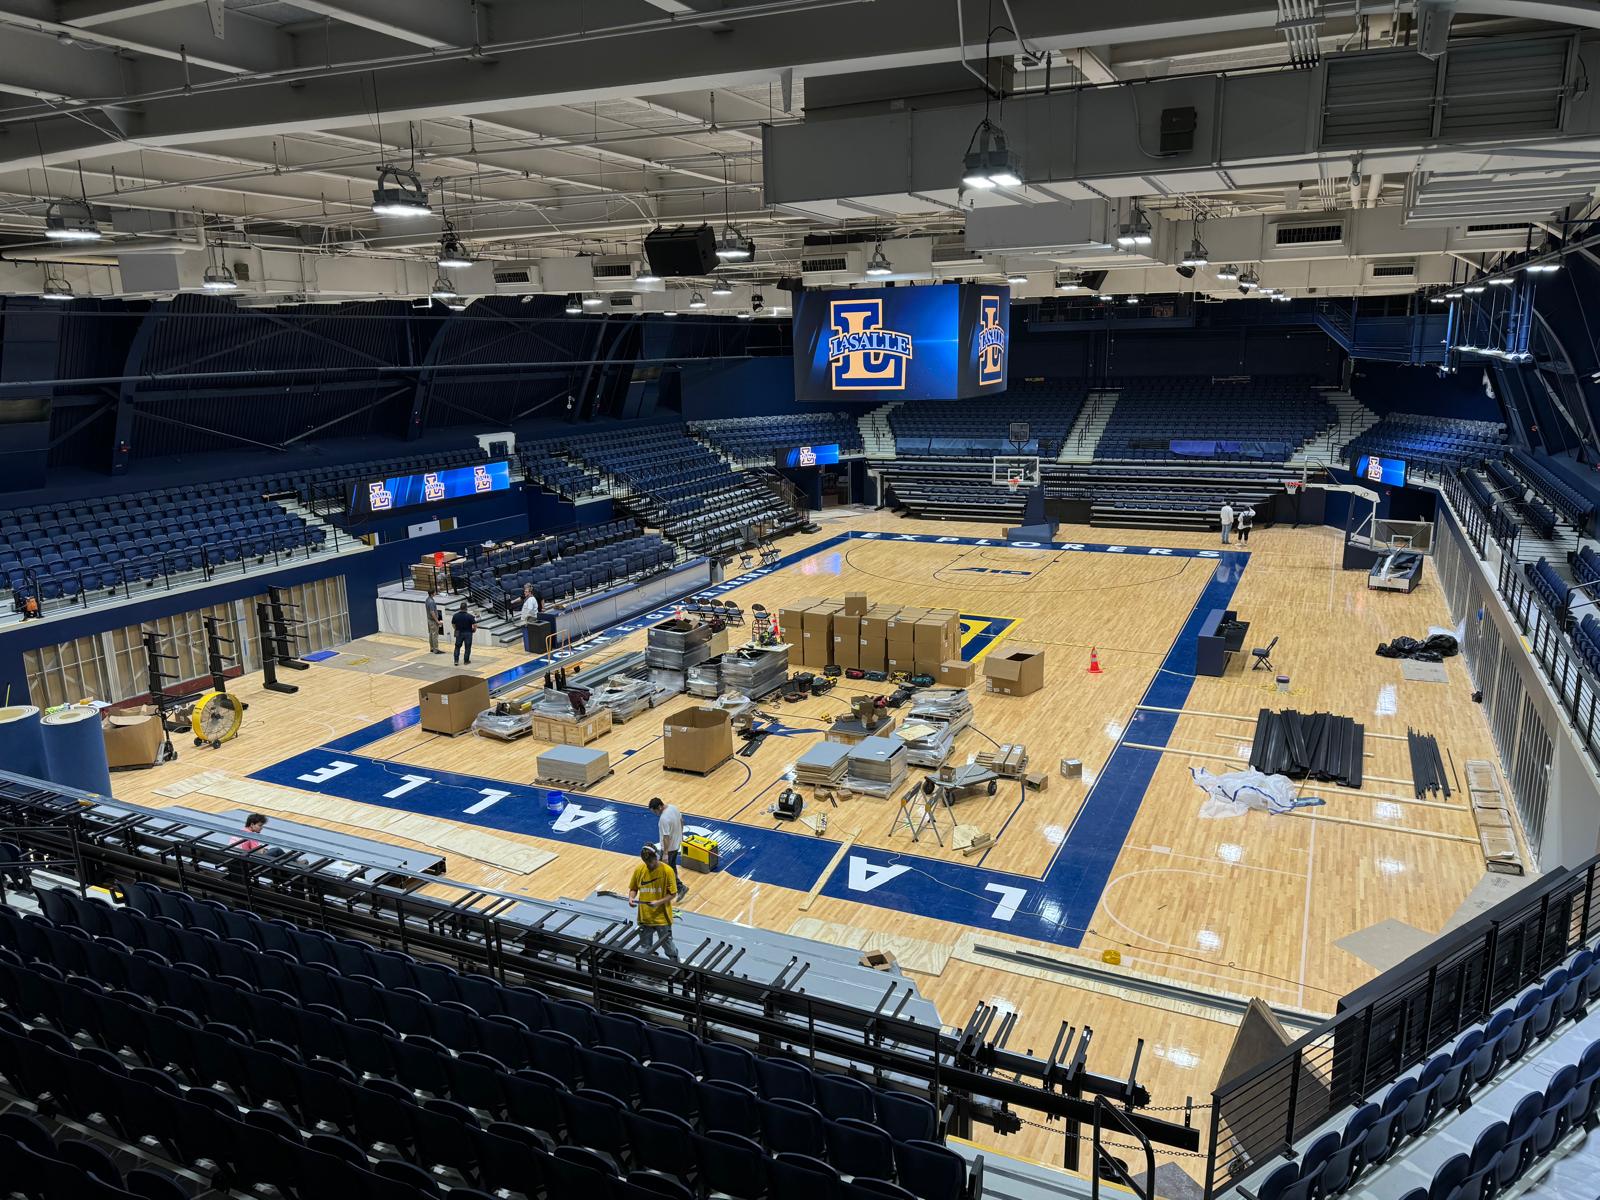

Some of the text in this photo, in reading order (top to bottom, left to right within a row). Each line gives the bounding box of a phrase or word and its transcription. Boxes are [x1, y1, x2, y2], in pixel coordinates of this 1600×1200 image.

[861, 532, 1220, 558] EXPLORERS
[539, 635, 612, 664] JOHN
[645, 591, 719, 619] GLAER
[718, 567, 773, 591] ARENA
[848, 855, 1027, 921] LA
